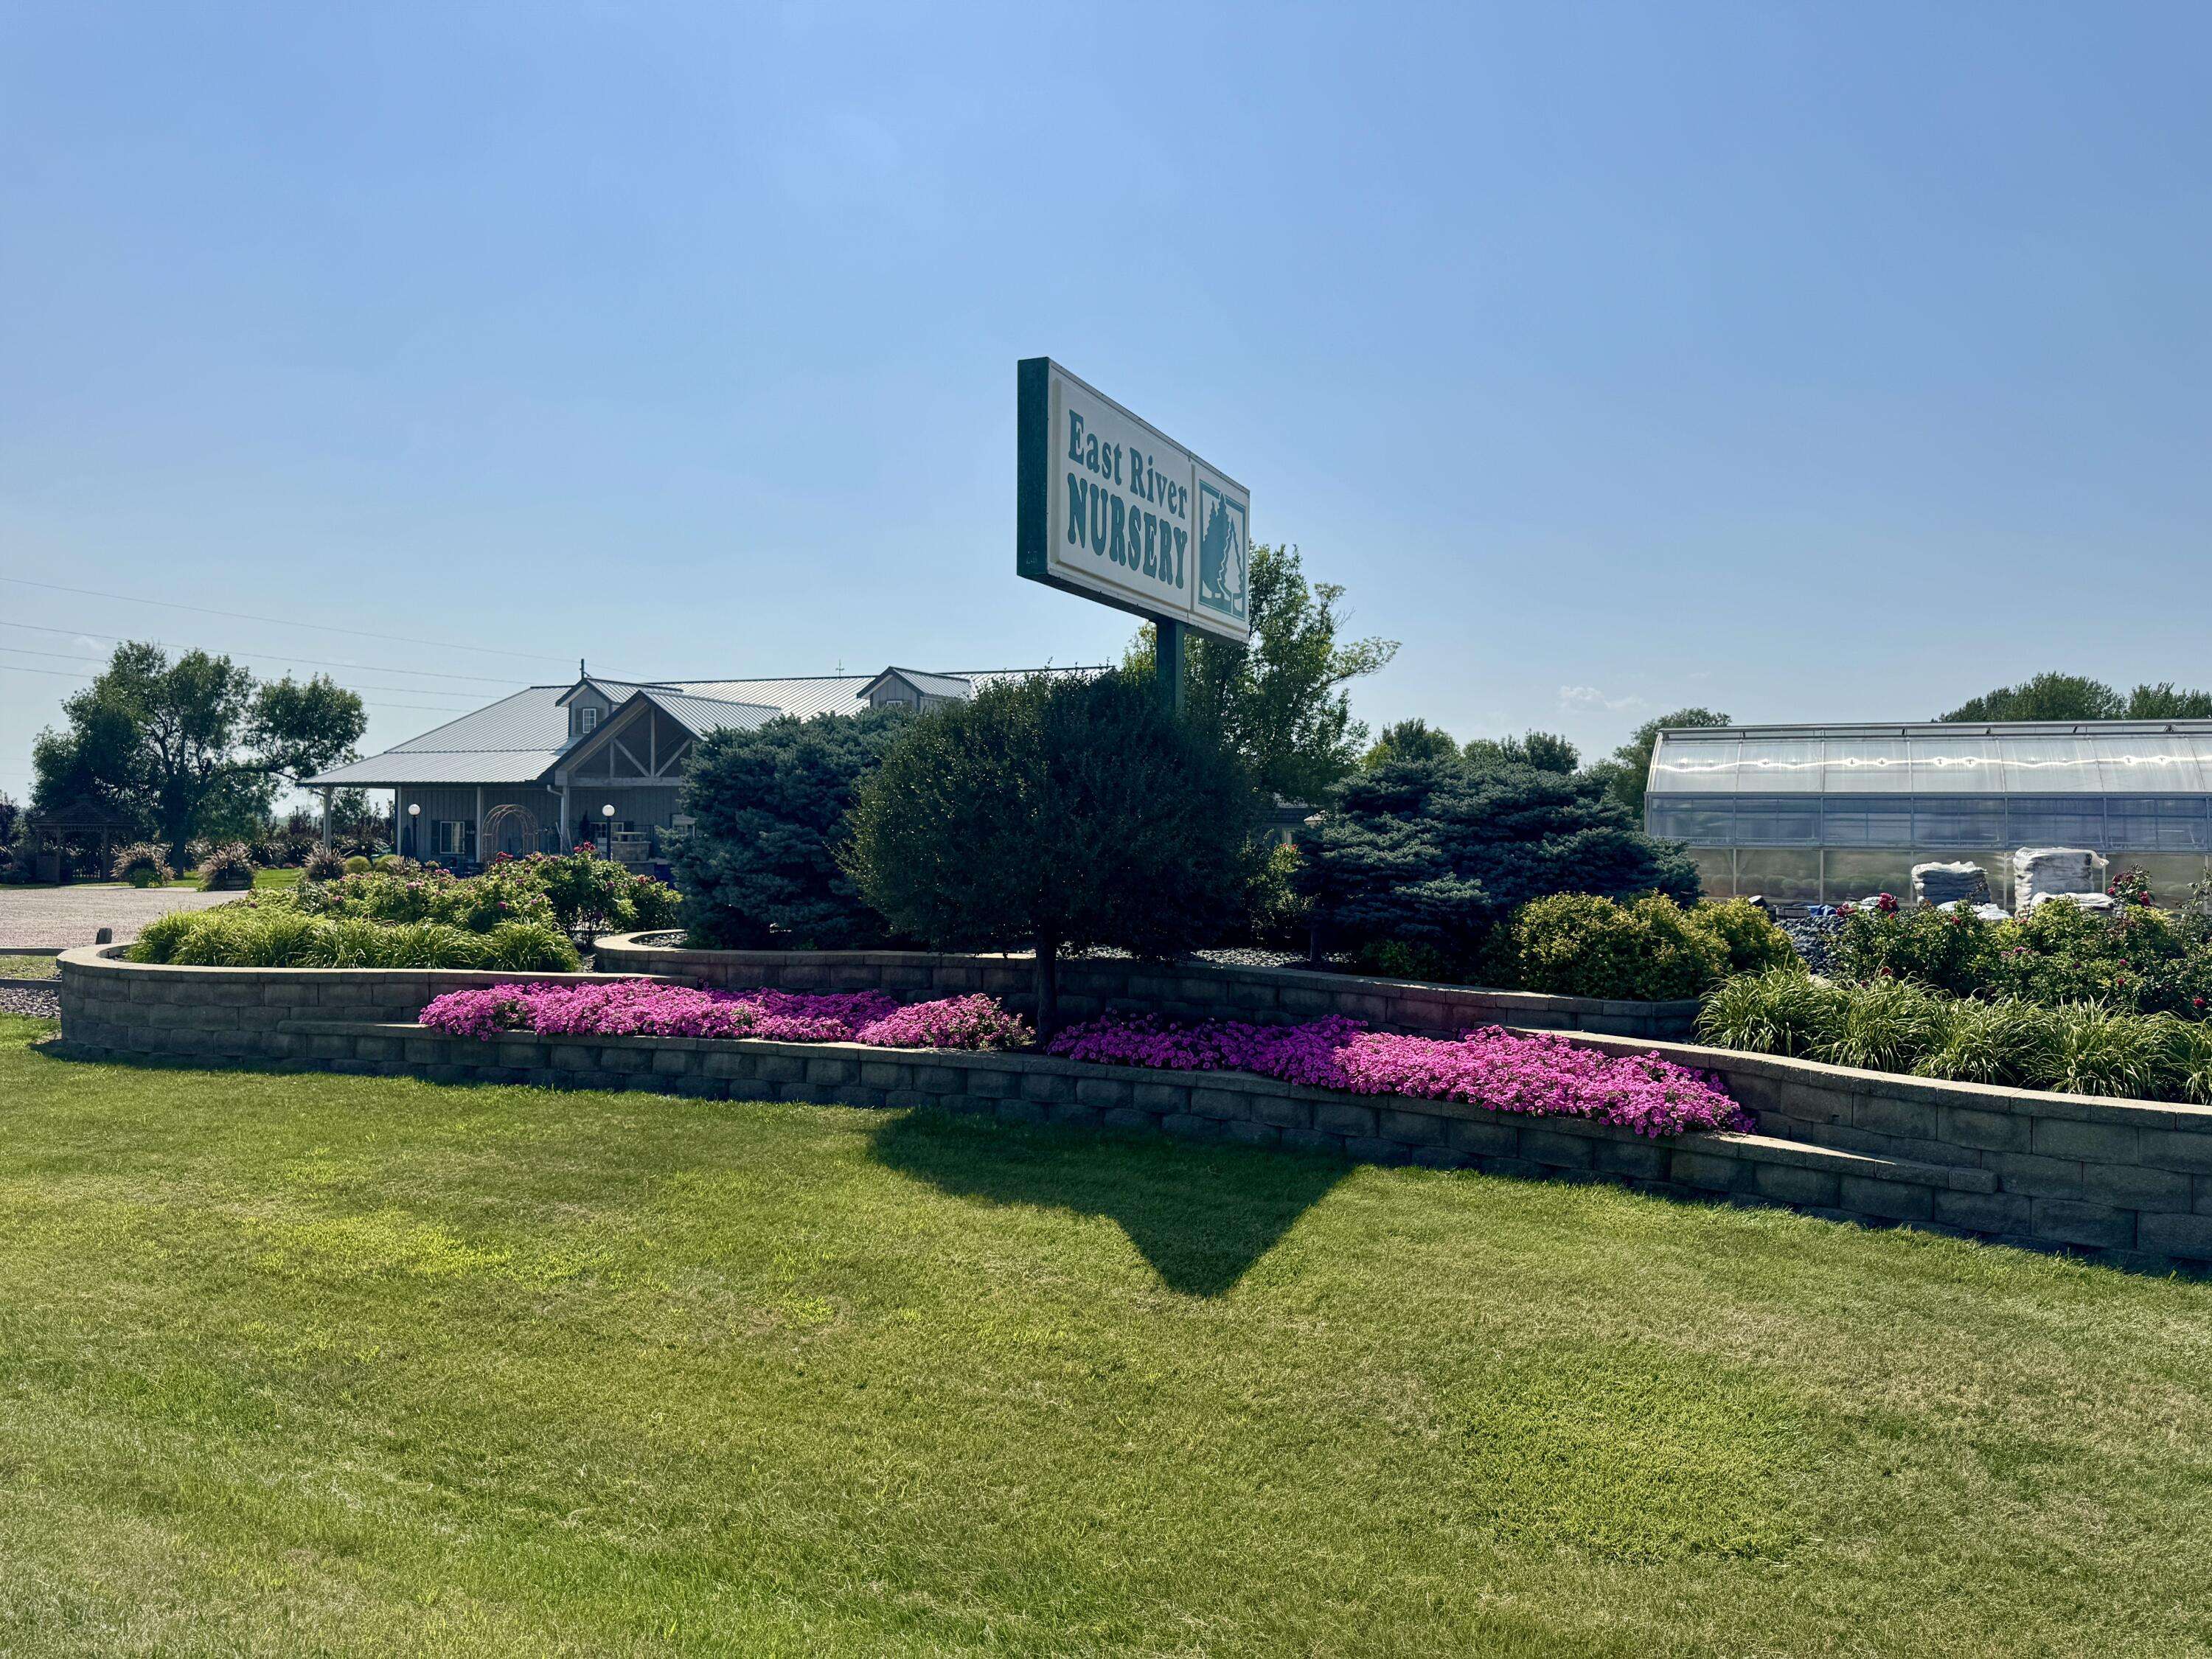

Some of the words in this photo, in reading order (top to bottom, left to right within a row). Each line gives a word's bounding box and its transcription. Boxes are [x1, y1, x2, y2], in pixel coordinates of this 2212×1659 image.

[1068, 408, 1122, 487] East
[1129, 447, 1188, 520] River
[1067, 472, 1188, 590] NURSERY
